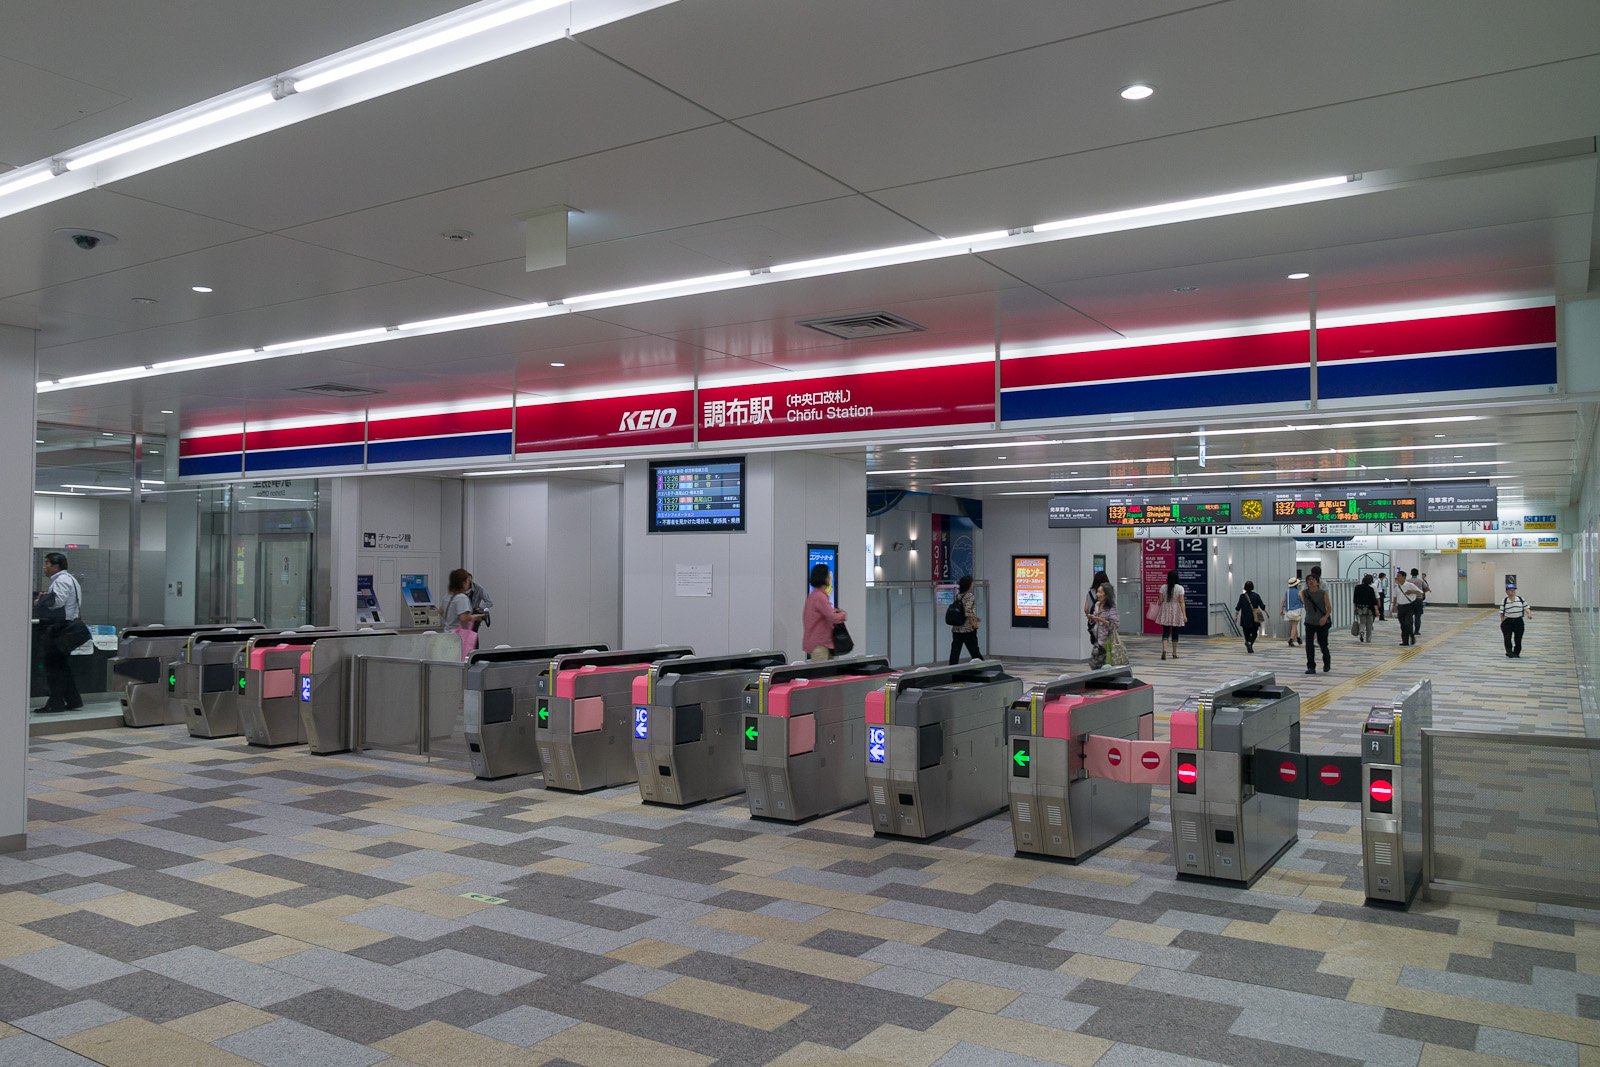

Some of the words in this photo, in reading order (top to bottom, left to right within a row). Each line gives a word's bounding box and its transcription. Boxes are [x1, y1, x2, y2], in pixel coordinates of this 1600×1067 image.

[618, 407, 678, 432] KEIO
[703, 396, 774, 429] 調布駅
[786, 408, 823, 423] Chōfu
[826, 405, 874, 419] Station
[377, 533, 412, 543] チャージ機
[302, 677, 311, 688] IC
[635, 708, 647, 722] IC
[869, 727, 885, 744] IC
